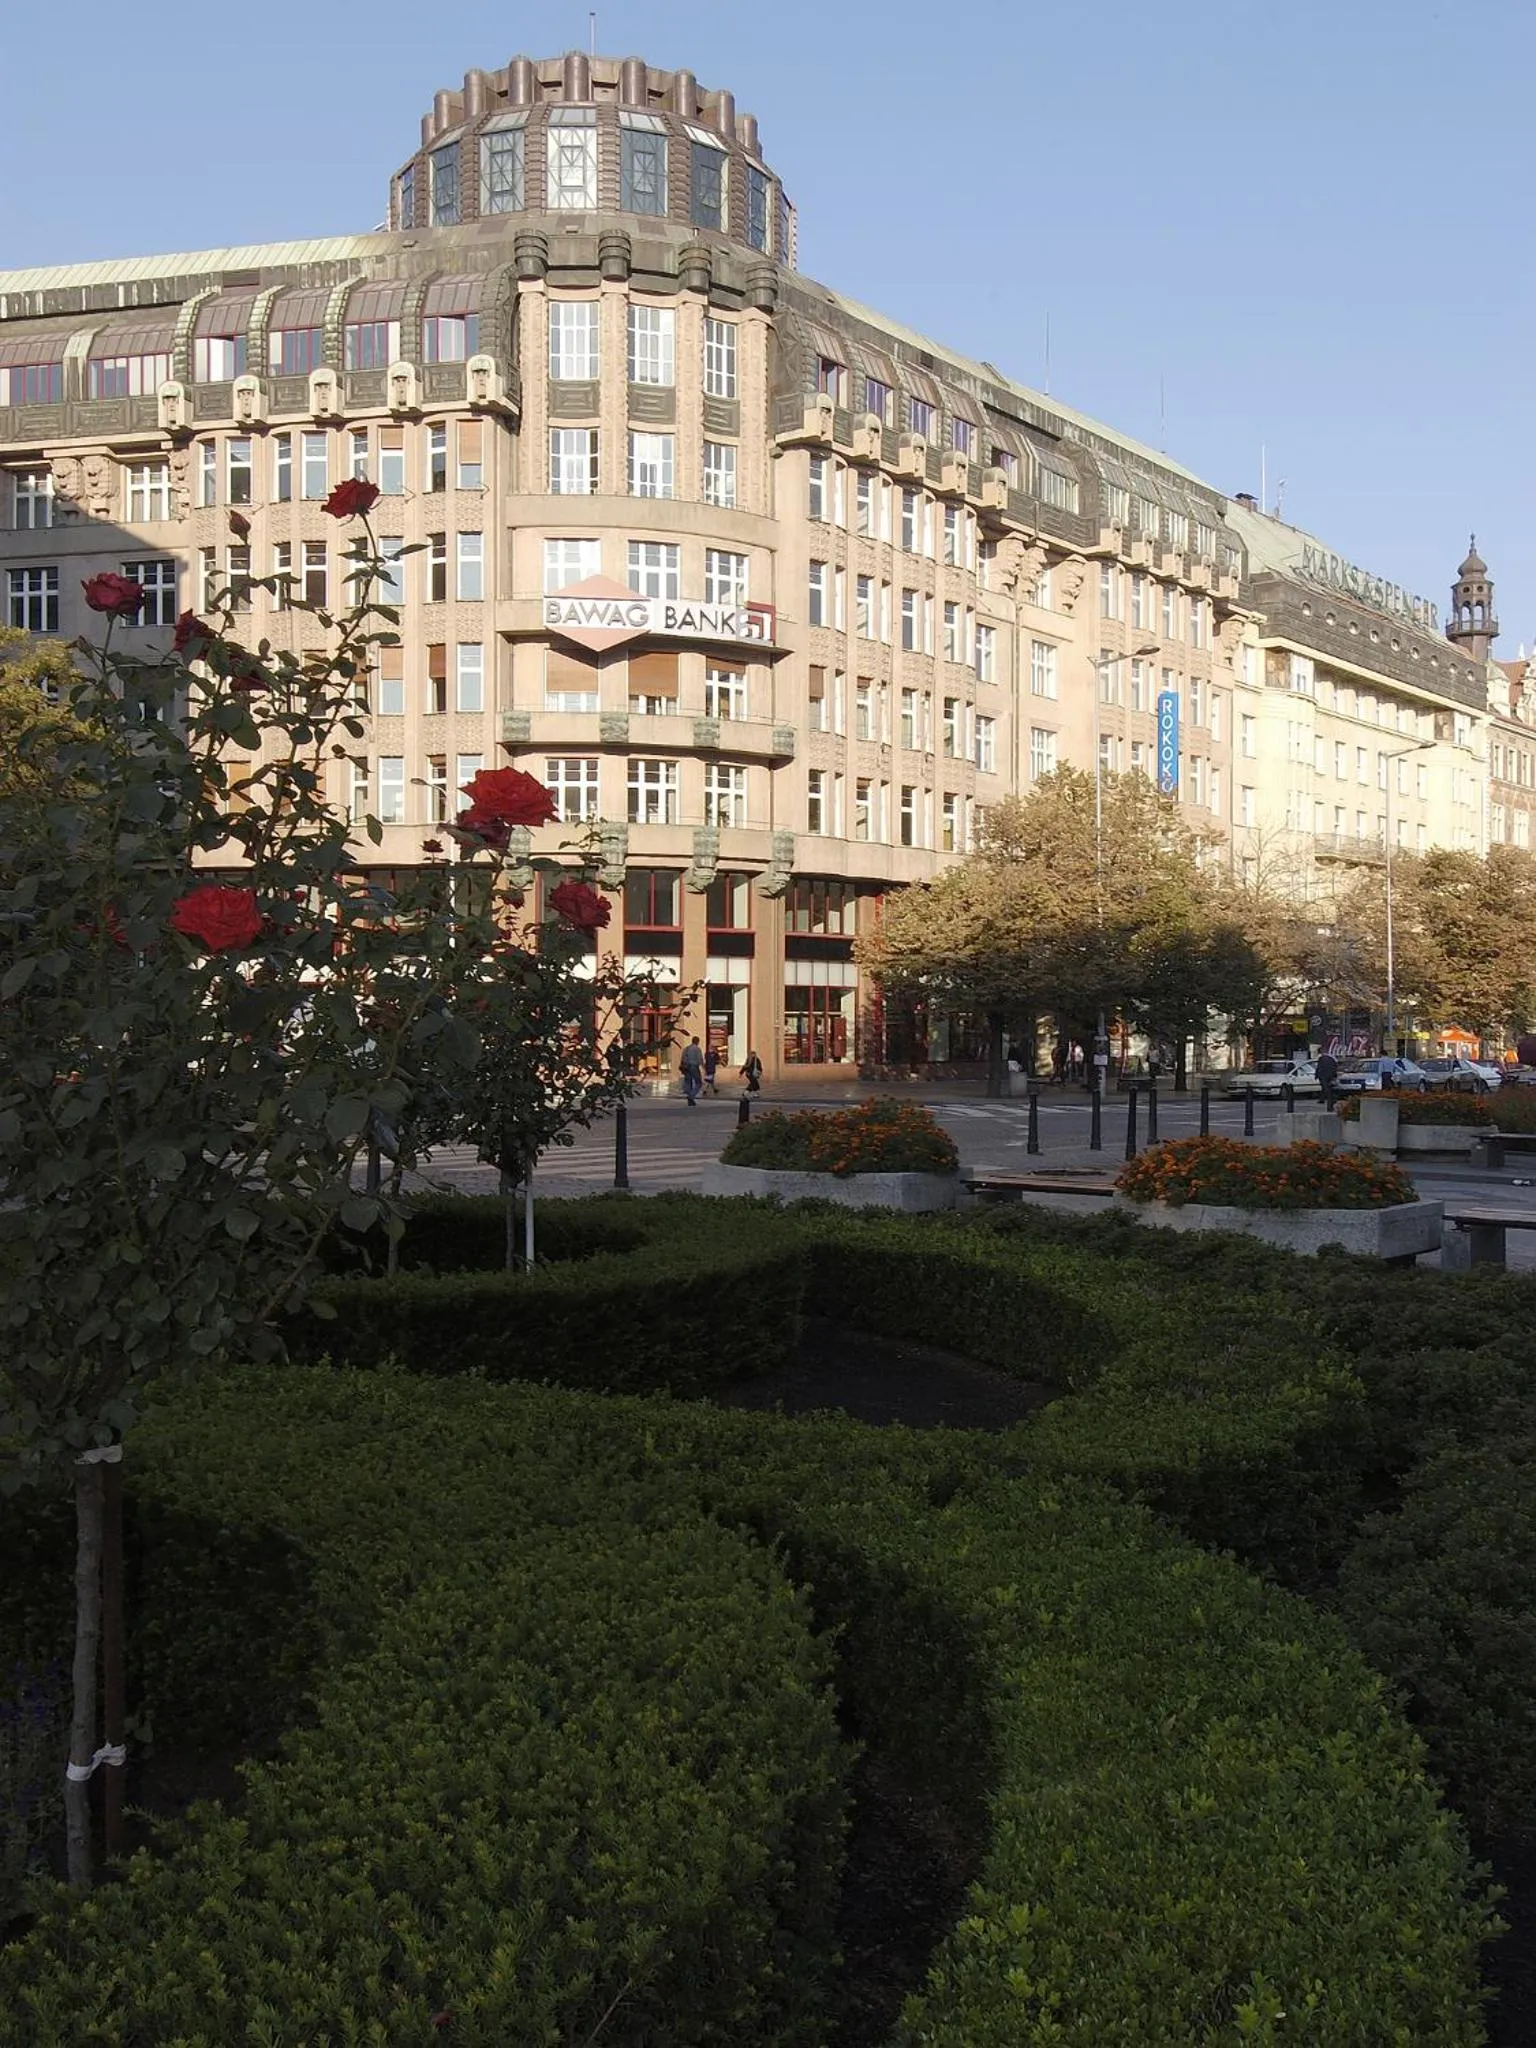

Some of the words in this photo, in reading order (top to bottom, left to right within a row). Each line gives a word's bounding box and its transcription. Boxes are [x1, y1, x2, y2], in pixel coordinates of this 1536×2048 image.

[1302, 541, 1360, 593] MARKS
[546, 600, 649, 627] BAWAG
[664, 605, 737, 635] BANK
[1161, 698, 1175, 793] ROKOKO
